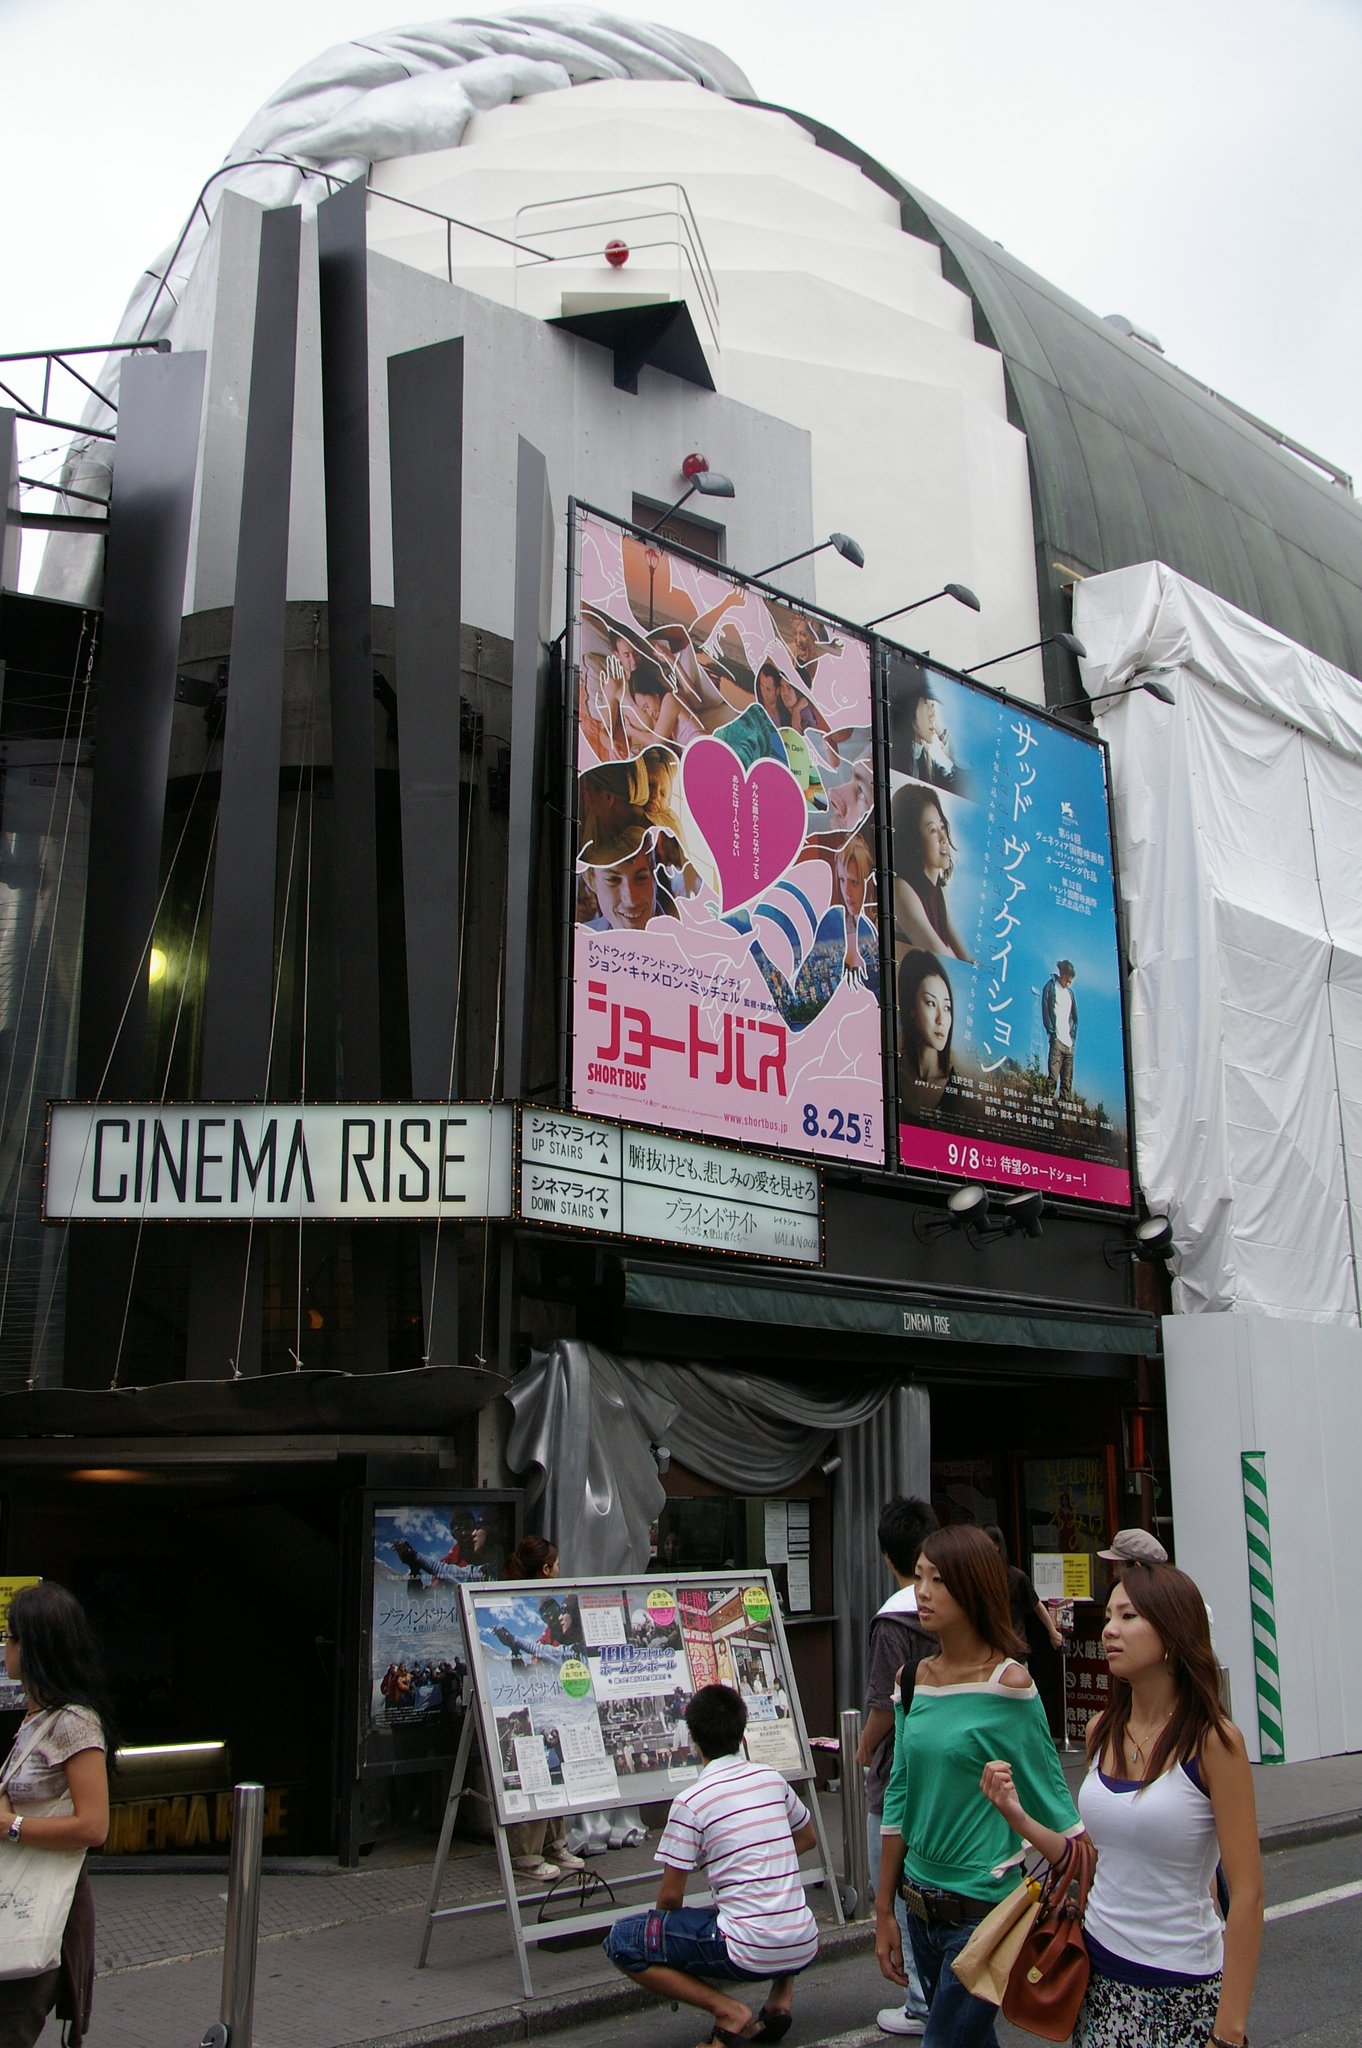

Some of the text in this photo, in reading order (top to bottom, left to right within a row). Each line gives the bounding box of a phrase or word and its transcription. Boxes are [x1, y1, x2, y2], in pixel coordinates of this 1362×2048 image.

[1010, 721, 1038, 822] サッド
[980, 834, 1031, 1072] ヴァケイション
[588, 980, 788, 1097] ショートバス
[587, 1062, 647, 1091] SHORTBUS
[531, 1118, 609, 1149] シネマライズ
[723, 1111, 789, 1134] www.shortbus.jp
[803, 1103, 862, 1145] 8.25
[92, 1119, 467, 1203] CINEMA RISE
[531, 1138, 583, 1160] UP STAIRS
[628, 1144, 816, 1201] 腑抜けども、悲しみの愛を見せろ
[531, 1175, 609, 1203] シネマライズ
[531, 1196, 594, 1219] DOWN STAIRS
[666, 1197, 758, 1234] ブラインドサイト
[773, 1216, 802, 1227] レイトショー
[903, 1312, 951, 1334] CINEMA RISE
